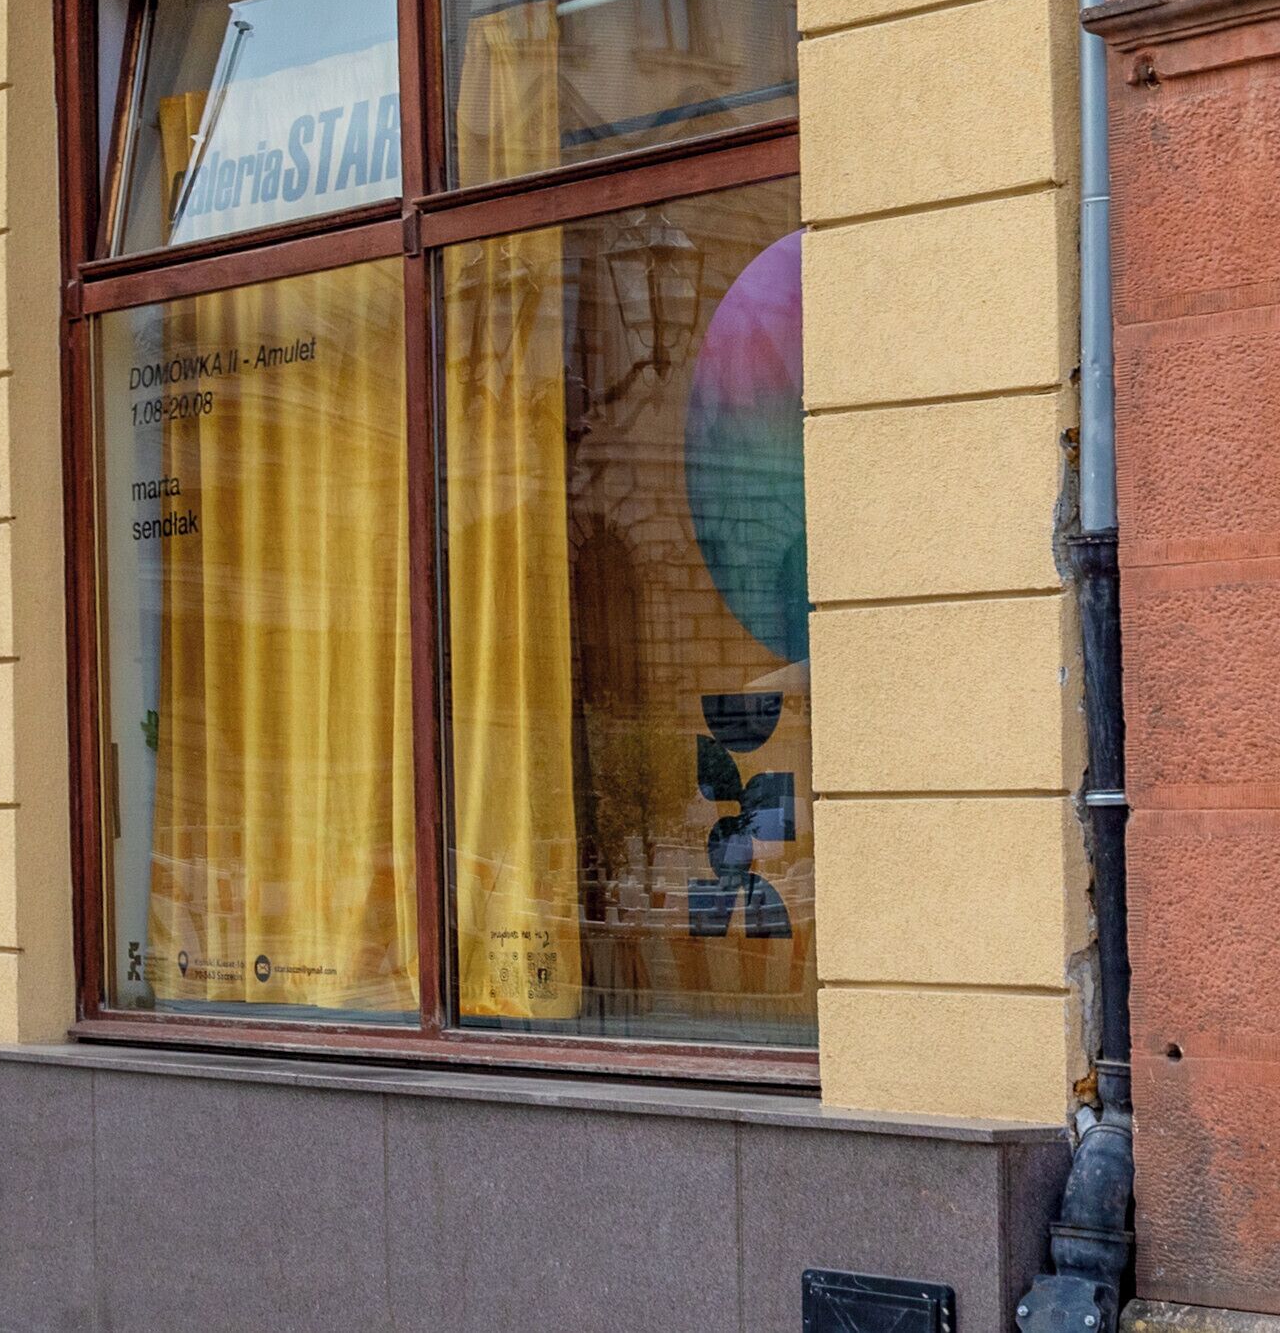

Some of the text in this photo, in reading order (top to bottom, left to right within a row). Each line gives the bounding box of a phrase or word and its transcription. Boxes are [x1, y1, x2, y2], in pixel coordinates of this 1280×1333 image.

[129, 351, 223, 390] DOMÓWKA
[228, 348, 238, 374] II
[254, 336, 317, 369] Amulet
[131, 390, 214, 427] 1.08-20.08
[132, 475, 181, 502] marta
[132, 509, 199, 541] sendłak
